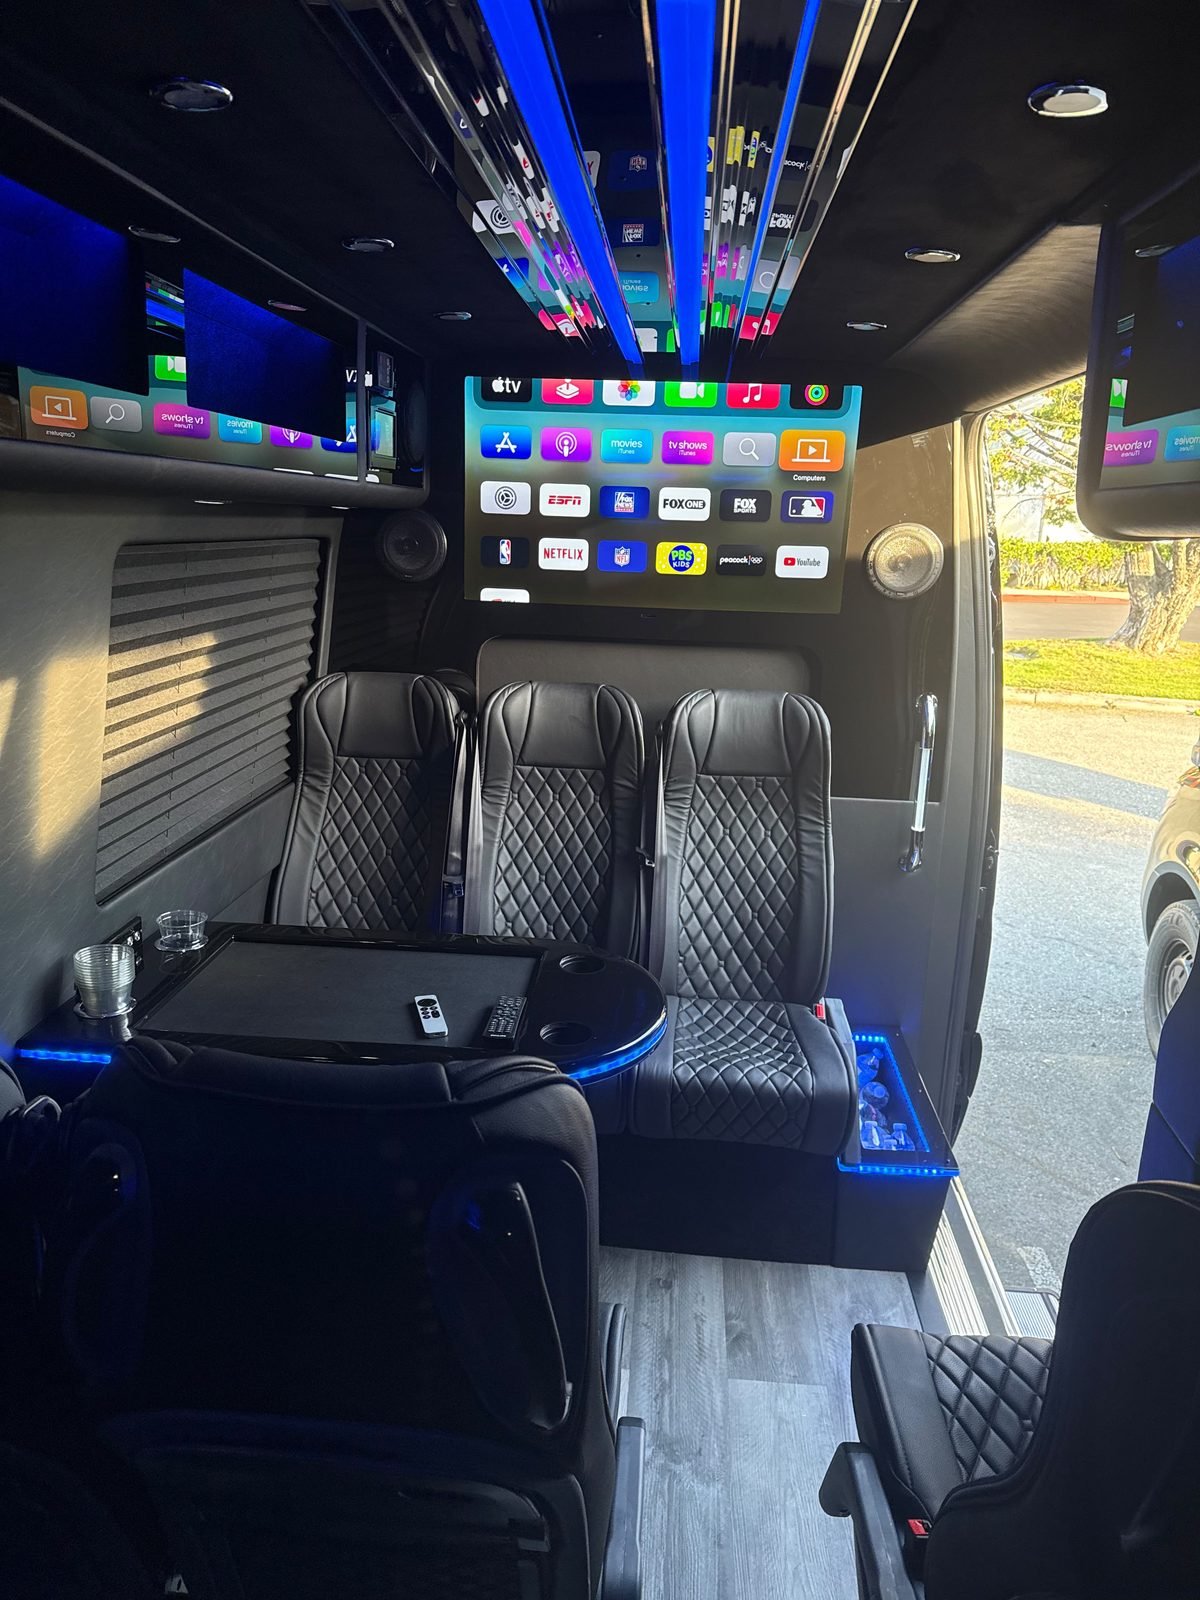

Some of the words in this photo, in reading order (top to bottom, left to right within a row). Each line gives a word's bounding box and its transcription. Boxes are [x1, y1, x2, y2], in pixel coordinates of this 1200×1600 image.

[504, 378, 521, 393] tv
[610, 438, 643, 449] movies
[668, 440, 678, 449] tv
[679, 440, 708, 450] shows
[793, 473, 826, 482] Computers
[548, 495, 582, 505] ESPN
[663, 498, 685, 509] FOX
[687, 500, 704, 509] ONE
[733, 498, 757, 508] FOX
[543, 548, 583, 561] NETFLIX
[671, 550, 693, 561] PBS
[673, 561, 691, 569] KIDS
[719, 556, 749, 566] peacock
[796, 557, 821, 567] YouTube
